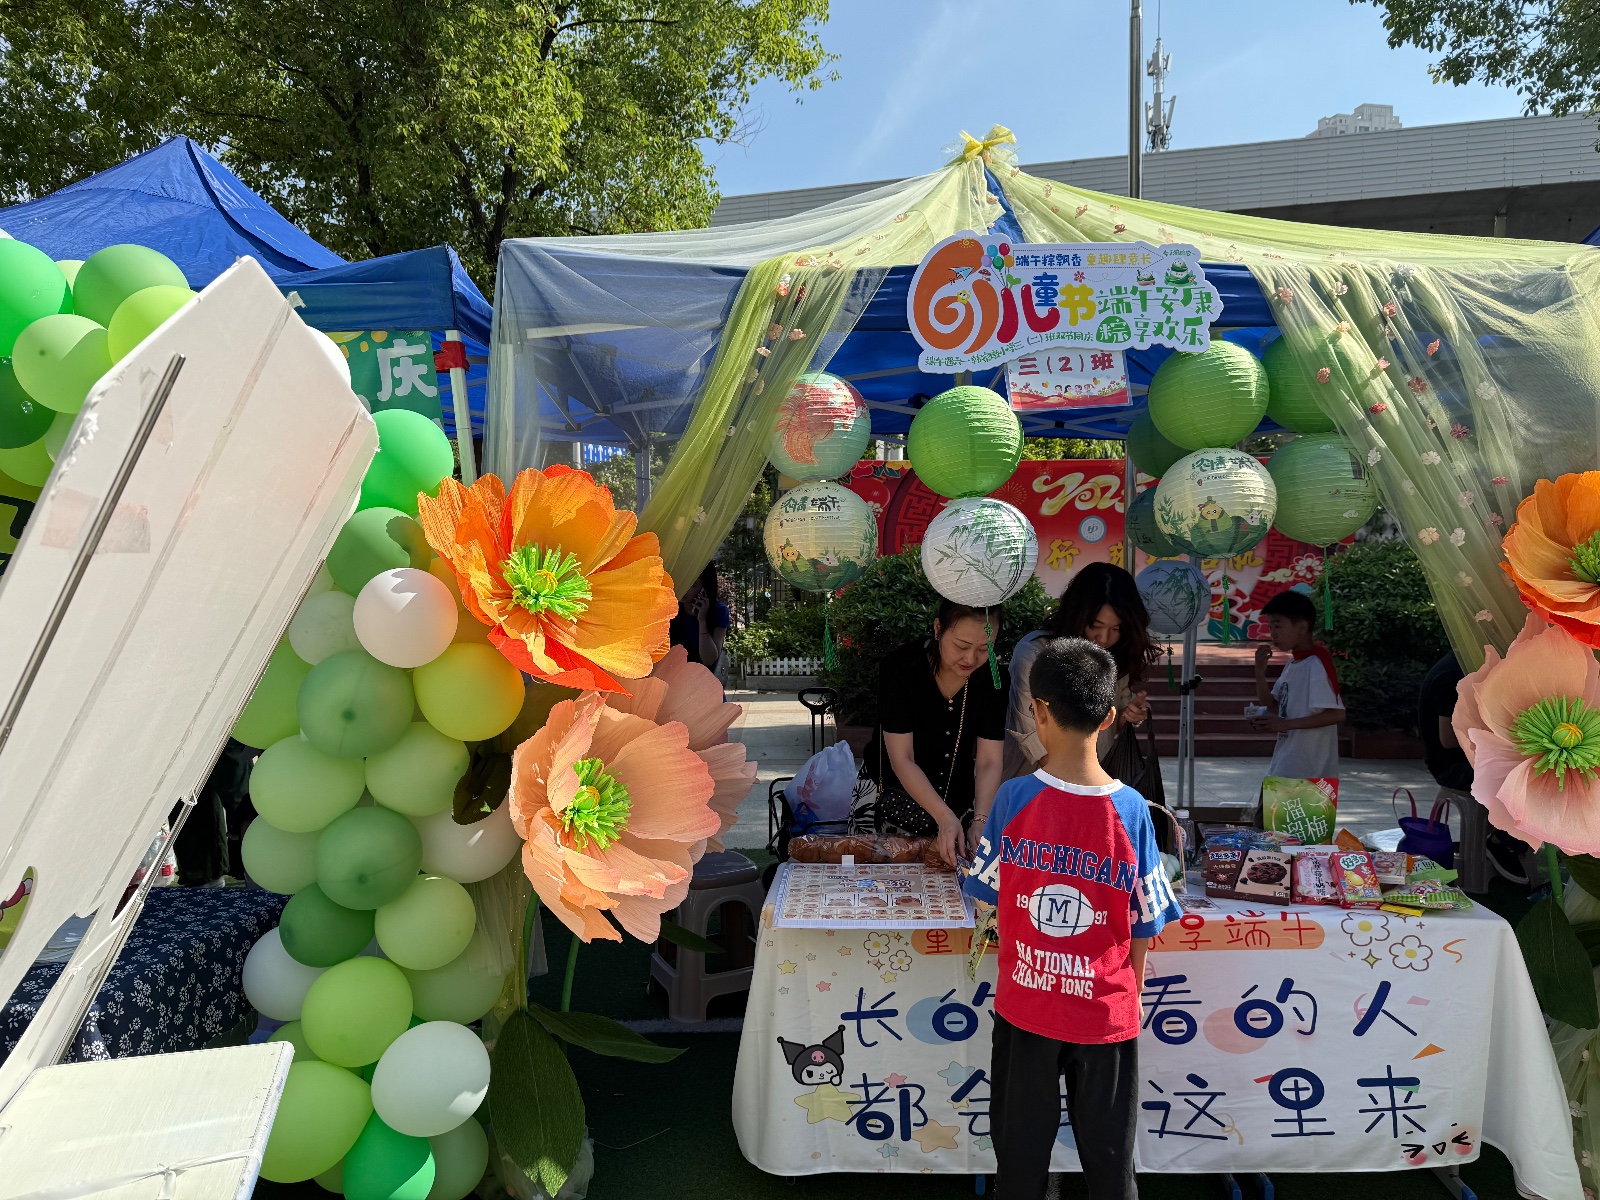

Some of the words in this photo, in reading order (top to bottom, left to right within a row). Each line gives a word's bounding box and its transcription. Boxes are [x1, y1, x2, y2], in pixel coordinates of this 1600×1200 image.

[1015, 254, 1082, 267] 端午粽飘香
[1096, 285, 1214, 315] 端午安康
[1097, 313, 1204, 346] 粽享欢乐
[376, 338, 438, 401] 庆
[1000, 836, 1138, 893] MICHIGAN
[1016, 893, 1028, 909] 19
[1046, 898, 1071, 924] M
[1094, 910, 1107, 925] 97
[1015, 940, 1095, 978] NATIONAL
